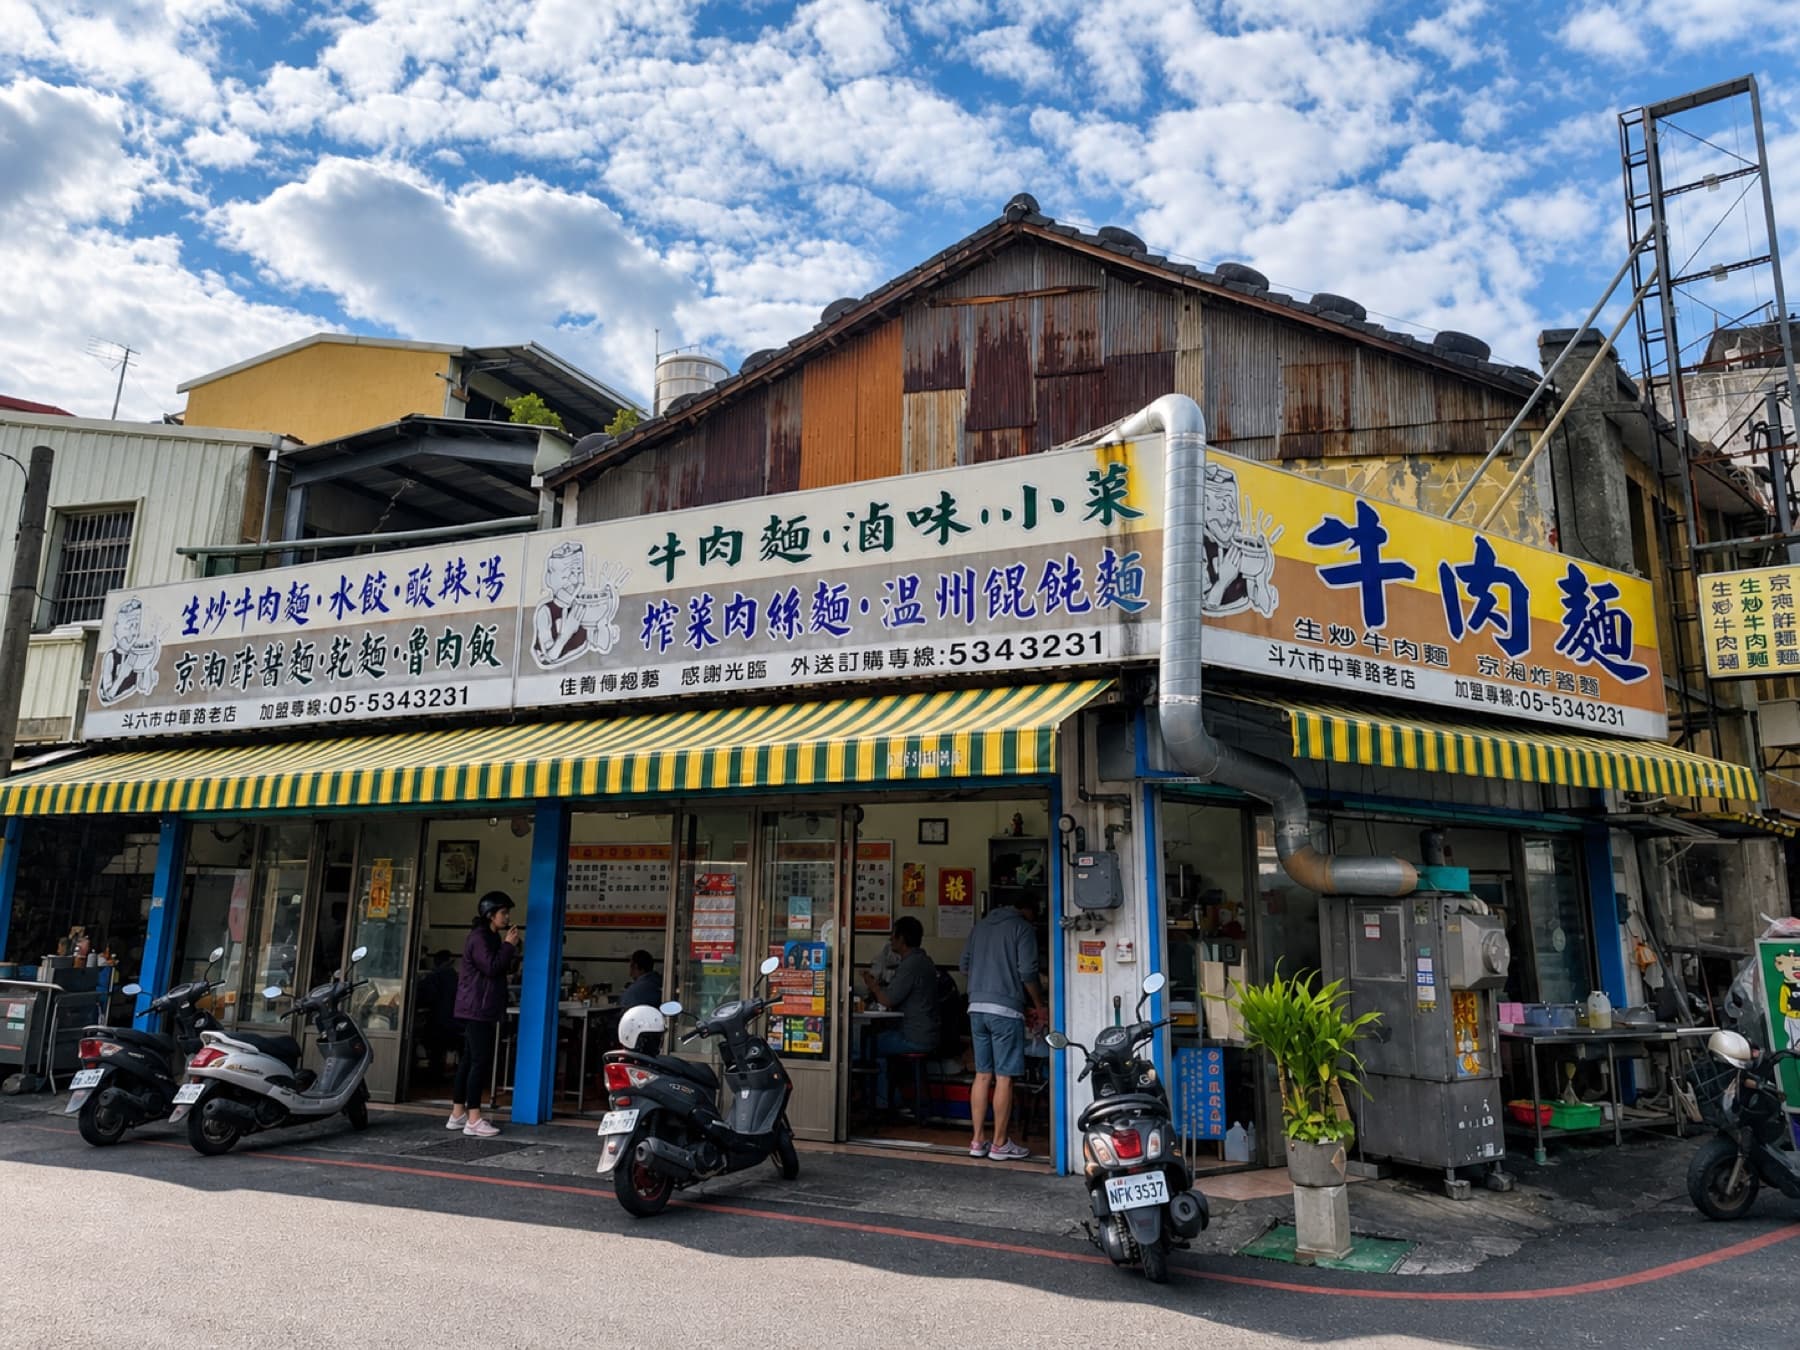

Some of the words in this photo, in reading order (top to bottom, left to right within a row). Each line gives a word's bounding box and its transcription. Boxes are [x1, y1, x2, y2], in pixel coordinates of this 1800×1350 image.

[1307, 500, 1648, 682] 牛肉麵
[1295, 618, 1449, 667] 生炒牛肉麵
[1739, 577, 1769, 668] 生炒牛肉麵
[681, 659, 767, 686] 感謝光臨
[1268, 643, 1416, 690] 斗六市中華路老店
[122, 705, 237, 730] 斗六市中華路老店
[1134, 1181, 1163, 1201] 3537
